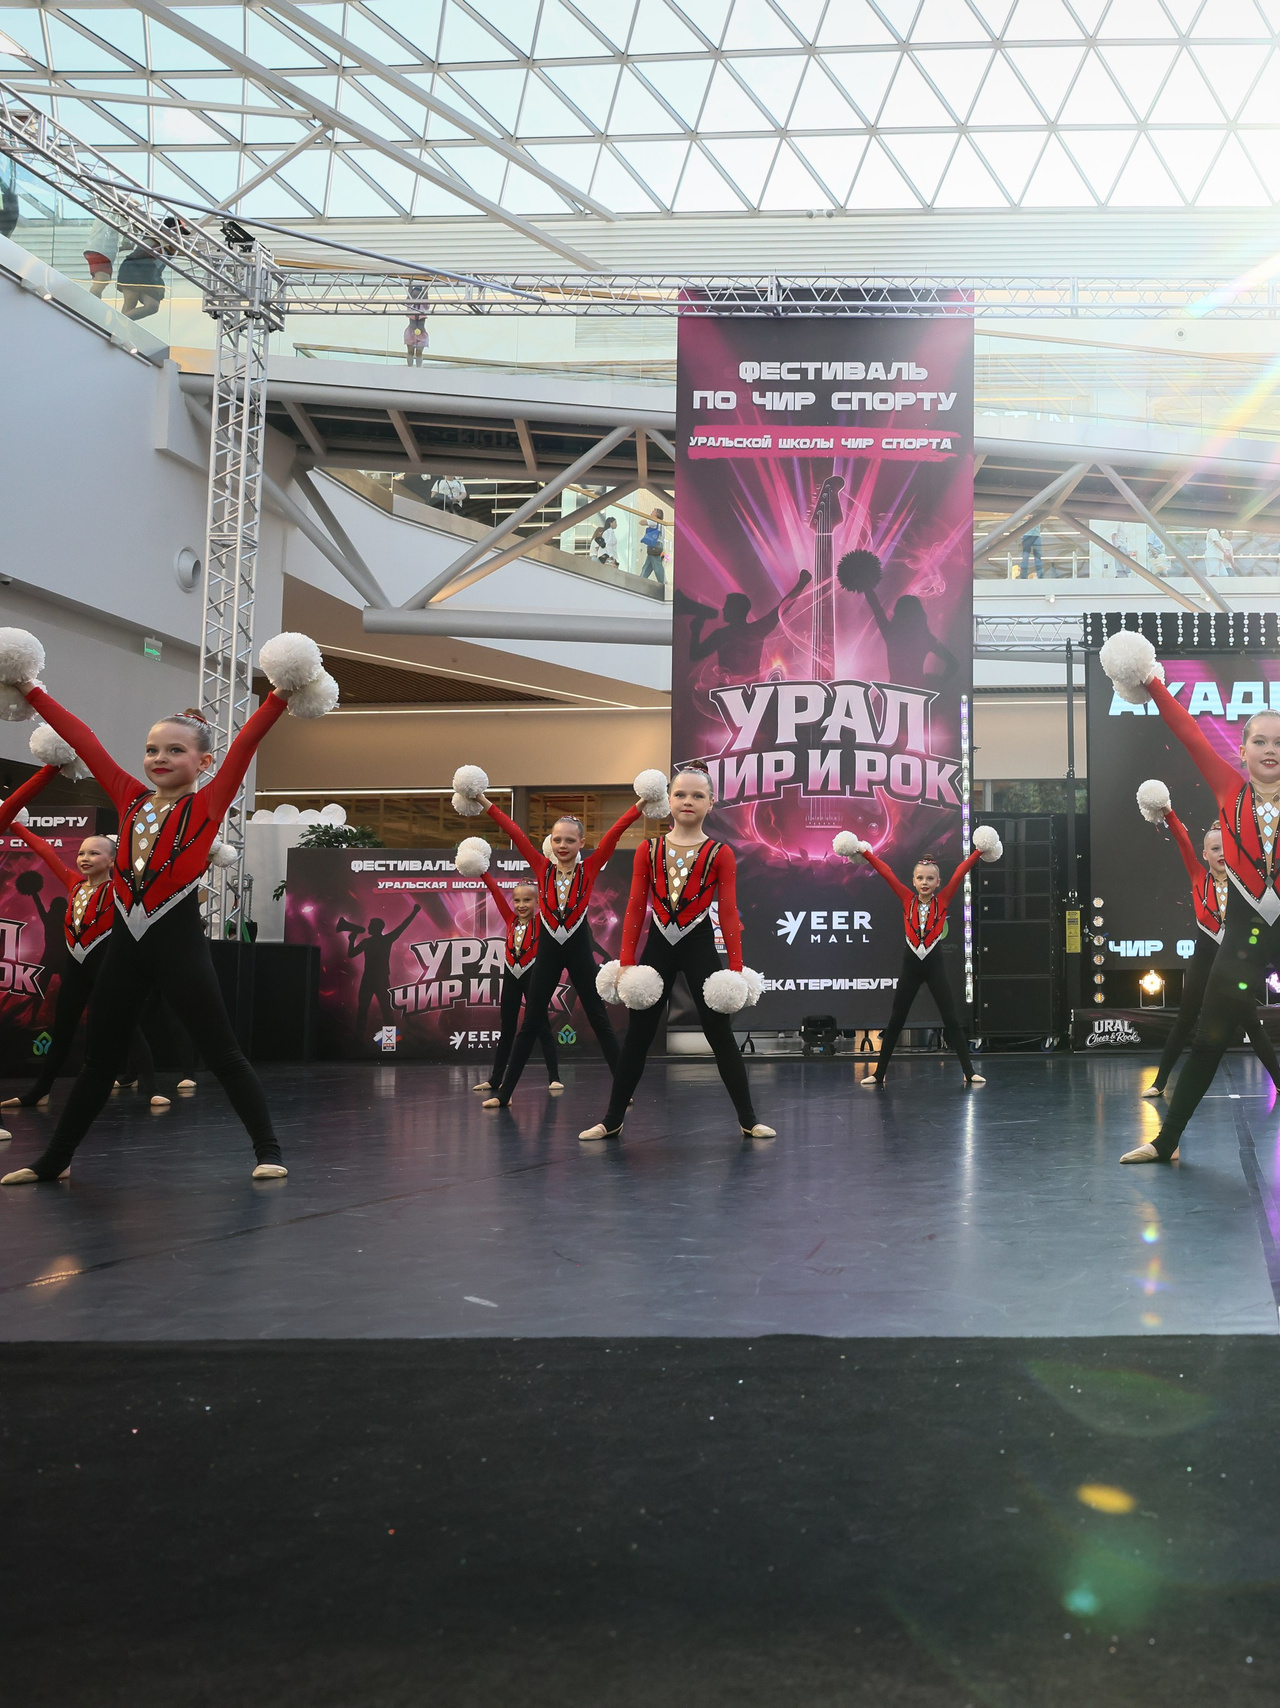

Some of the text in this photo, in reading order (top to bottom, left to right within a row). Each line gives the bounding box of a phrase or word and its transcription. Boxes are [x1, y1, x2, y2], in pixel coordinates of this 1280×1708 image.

[738, 361, 928, 383] ФЕСТИВАЛЬ
[692, 390, 957, 412] ПО ЧИР СПОРТУ
[689, 434, 952, 450] УРАЛЬСКОЙ ШКОЛЫ ЧИР СПОРТА
[713, 682, 933, 756] УРАЛ
[808, 749, 844, 792] И
[854, 750, 962, 806] РОК
[26, 816, 89, 828] ПОРТУ
[10, 838, 63, 847] СПТА
[350, 860, 530, 873] ФЕСТИВАЛЬ ЧИР
[377, 881, 447, 889] УРАЛЬСКАЯ
[776, 911, 873, 945] YEER
[811, 934, 870, 943] MALL
[1108, 940, 1164, 957] ЧИР
[412, 938, 506, 981] УРА
[394, 979, 462, 1014] ЧИР
[470, 978, 491, 1004] И
[1093, 1019, 1133, 1034] URAL
[1086, 1033, 1110, 1046] Cheer
[1115, 1031, 1140, 1043] Rock
